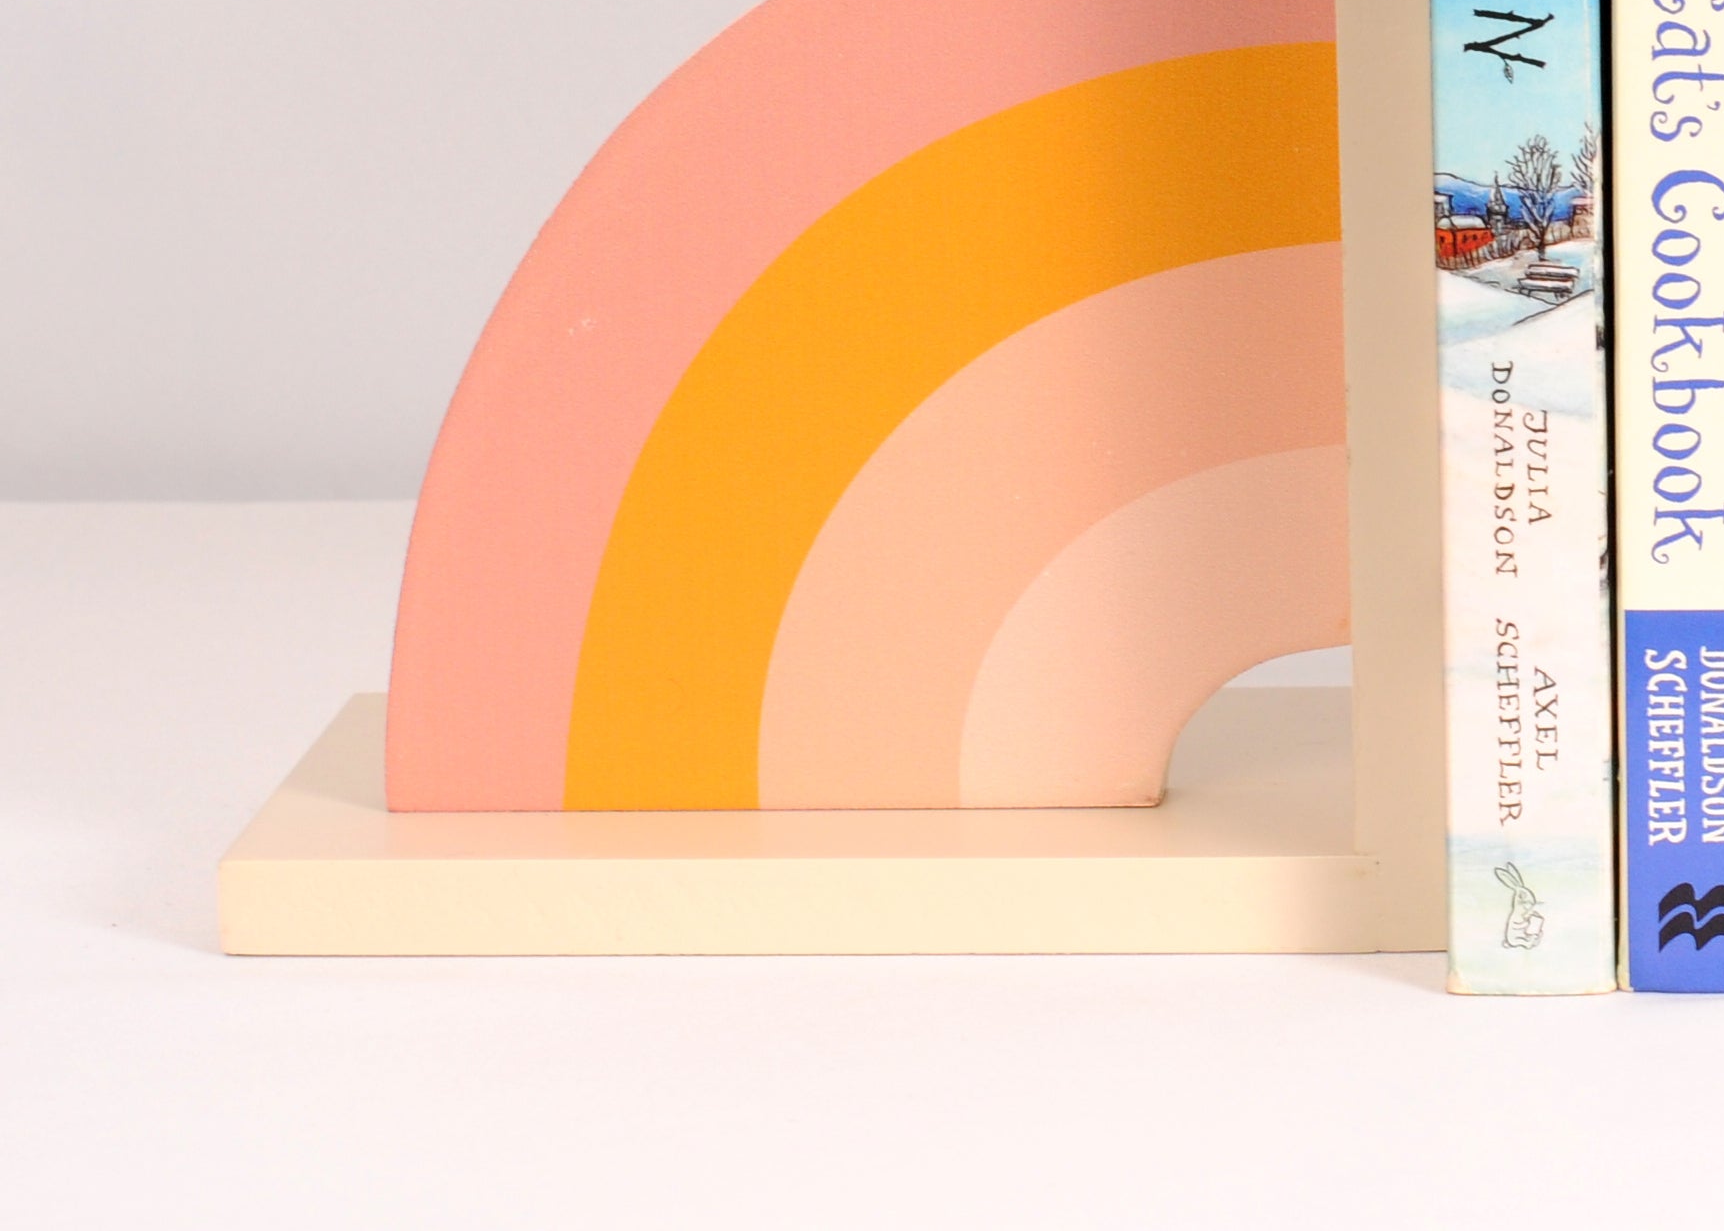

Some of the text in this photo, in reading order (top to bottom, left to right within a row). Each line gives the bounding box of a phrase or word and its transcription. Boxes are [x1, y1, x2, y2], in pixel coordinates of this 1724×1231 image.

[1491, 361, 1518, 578] DONALDSON
[1522, 410, 1552, 526] JULIA
[1494, 618, 1523, 826] SCHEFFLER
[1533, 667, 1562, 771] AXEL
[1644, 648, 1688, 847] SCHEFFLER
